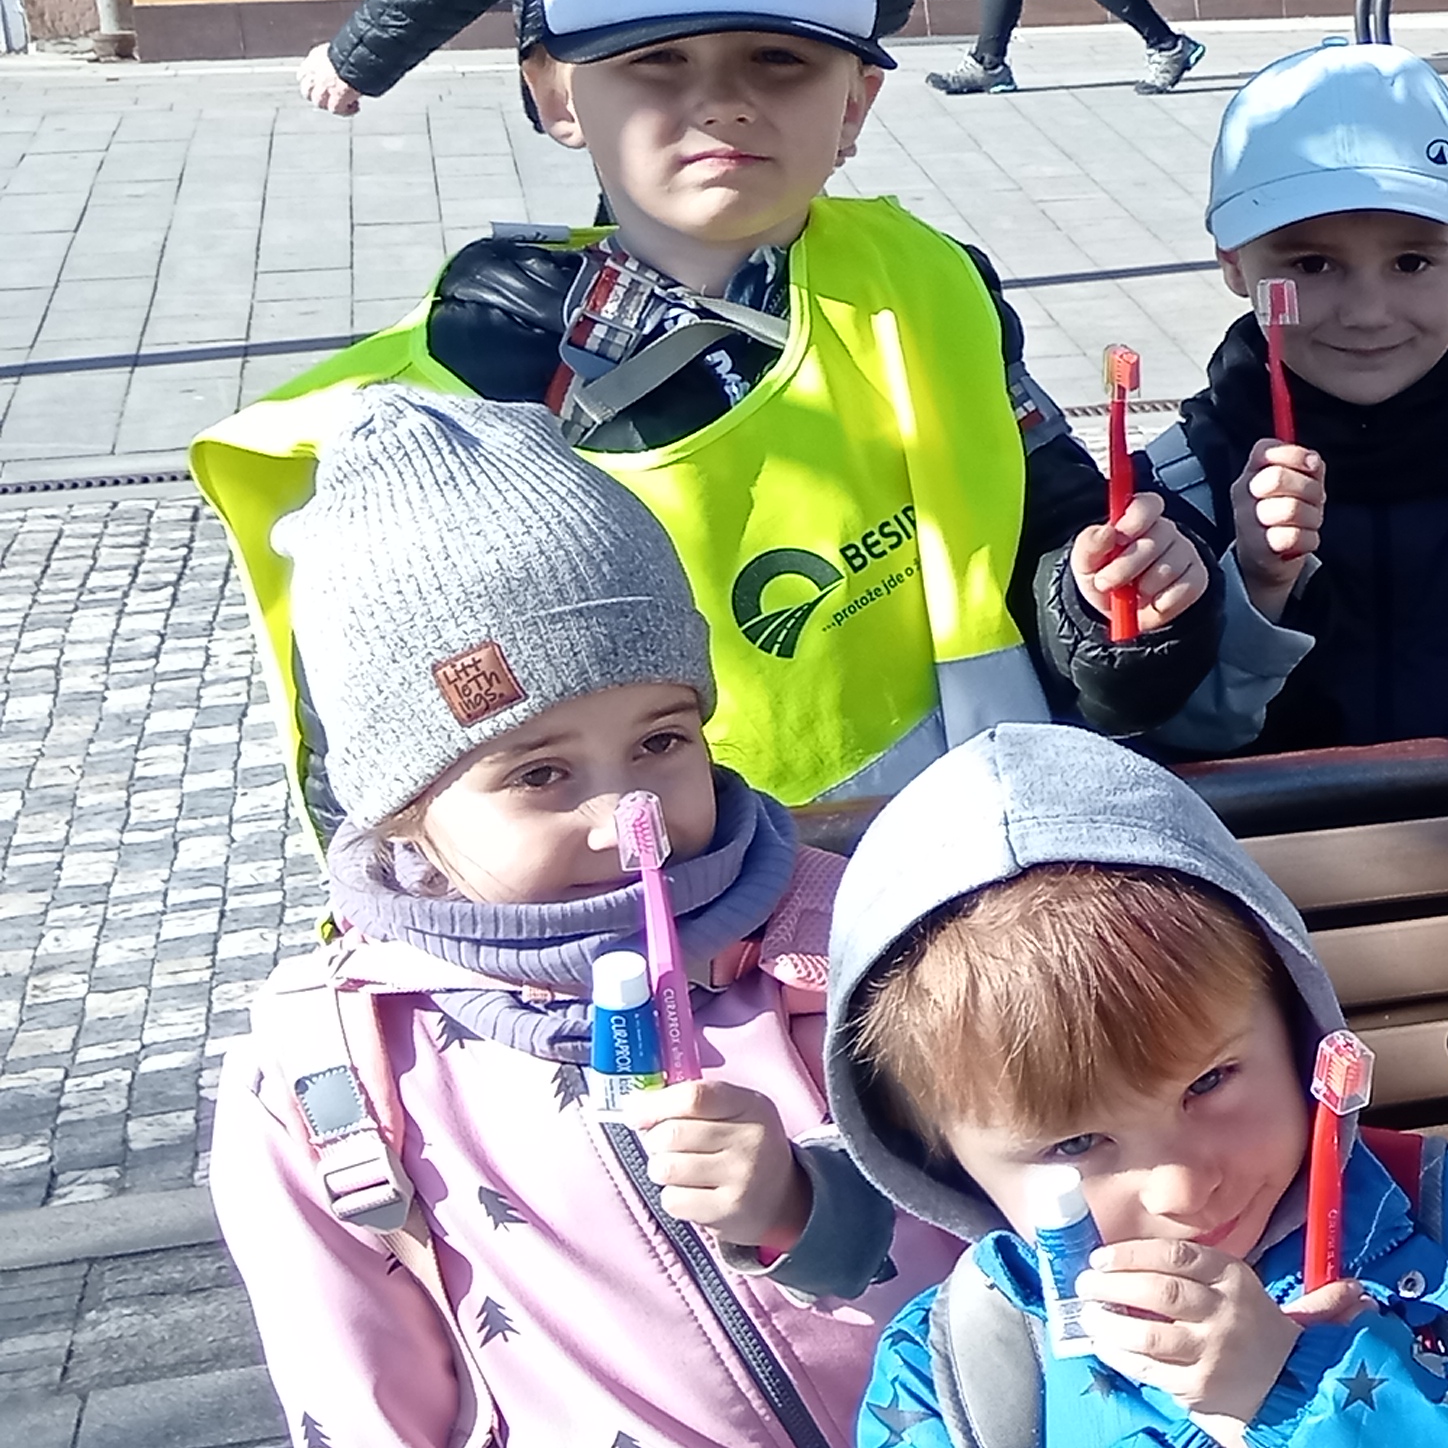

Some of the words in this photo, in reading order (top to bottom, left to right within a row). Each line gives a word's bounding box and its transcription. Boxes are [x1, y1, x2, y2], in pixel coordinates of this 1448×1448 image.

[881, 573, 906, 595] jde
[905, 566, 915, 578] o
[610, 1014, 633, 1073] CURAPROX
[662, 987, 681, 1044] CURAPROX
